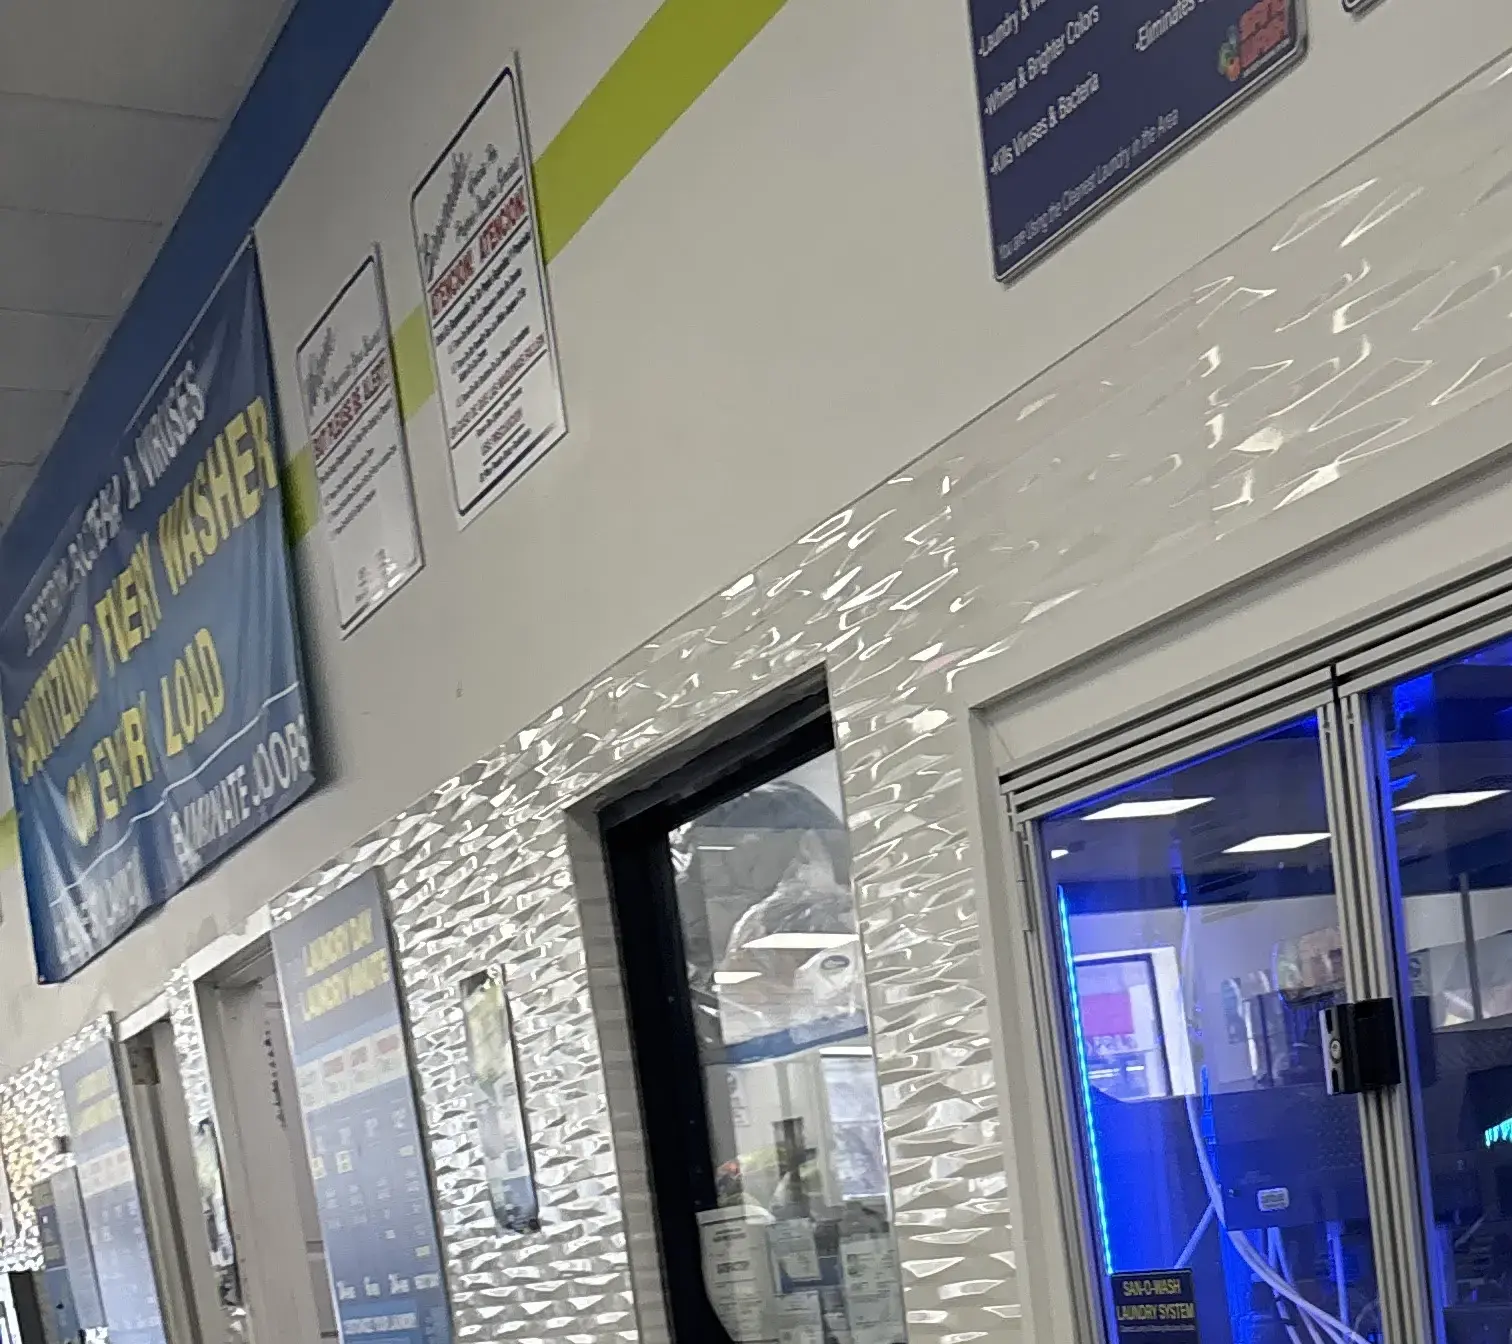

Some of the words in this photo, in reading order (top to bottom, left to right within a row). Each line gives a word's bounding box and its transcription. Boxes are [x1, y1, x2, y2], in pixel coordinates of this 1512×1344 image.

[1065, 5, 1100, 45] Colors
[1012, 117, 1049, 157] Viruses
[1057, 71, 1100, 120] Bacteria
[158, 396, 279, 597] WASHER
[160, 628, 226, 757] LOAD
[1158, 1303, 1195, 1320] SYSTEM
